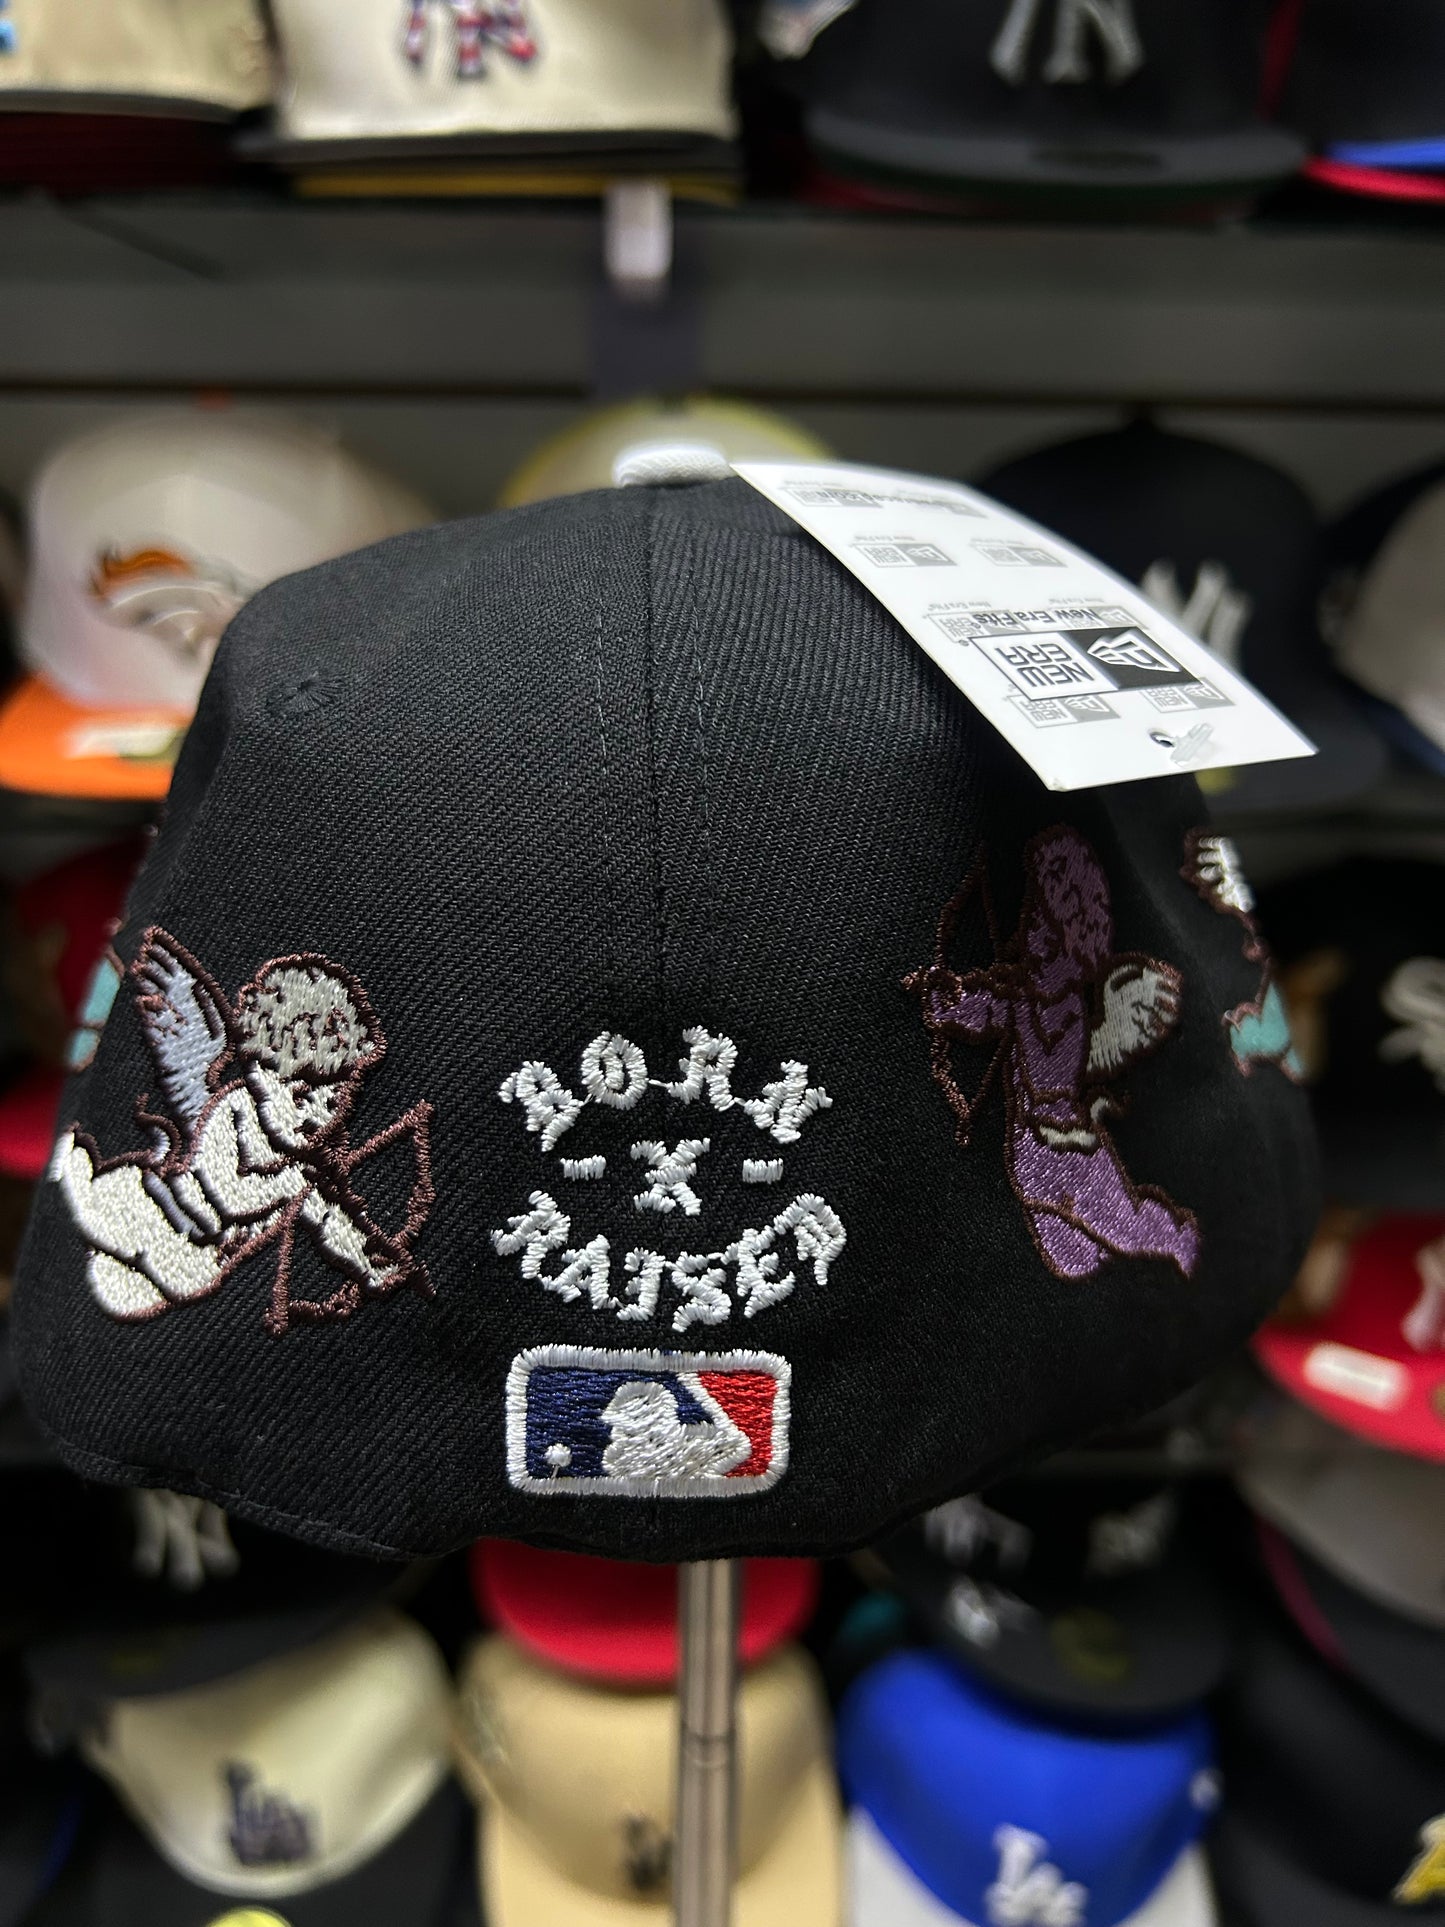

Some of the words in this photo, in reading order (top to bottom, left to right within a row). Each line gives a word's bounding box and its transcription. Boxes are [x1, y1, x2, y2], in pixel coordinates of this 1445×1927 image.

[1014, 610, 1057, 624] Era
[1054, 608, 1099, 622] New
[994, 643, 1073, 666] ERA
[1016, 661, 1095, 688] NEW
[1155, 695, 1190, 708] NEW
[1029, 706, 1070, 722] NEW
[498, 1025, 833, 1152] BORN
[630, 1137, 711, 1216] X
[491, 1190, 847, 1333] RAISED
